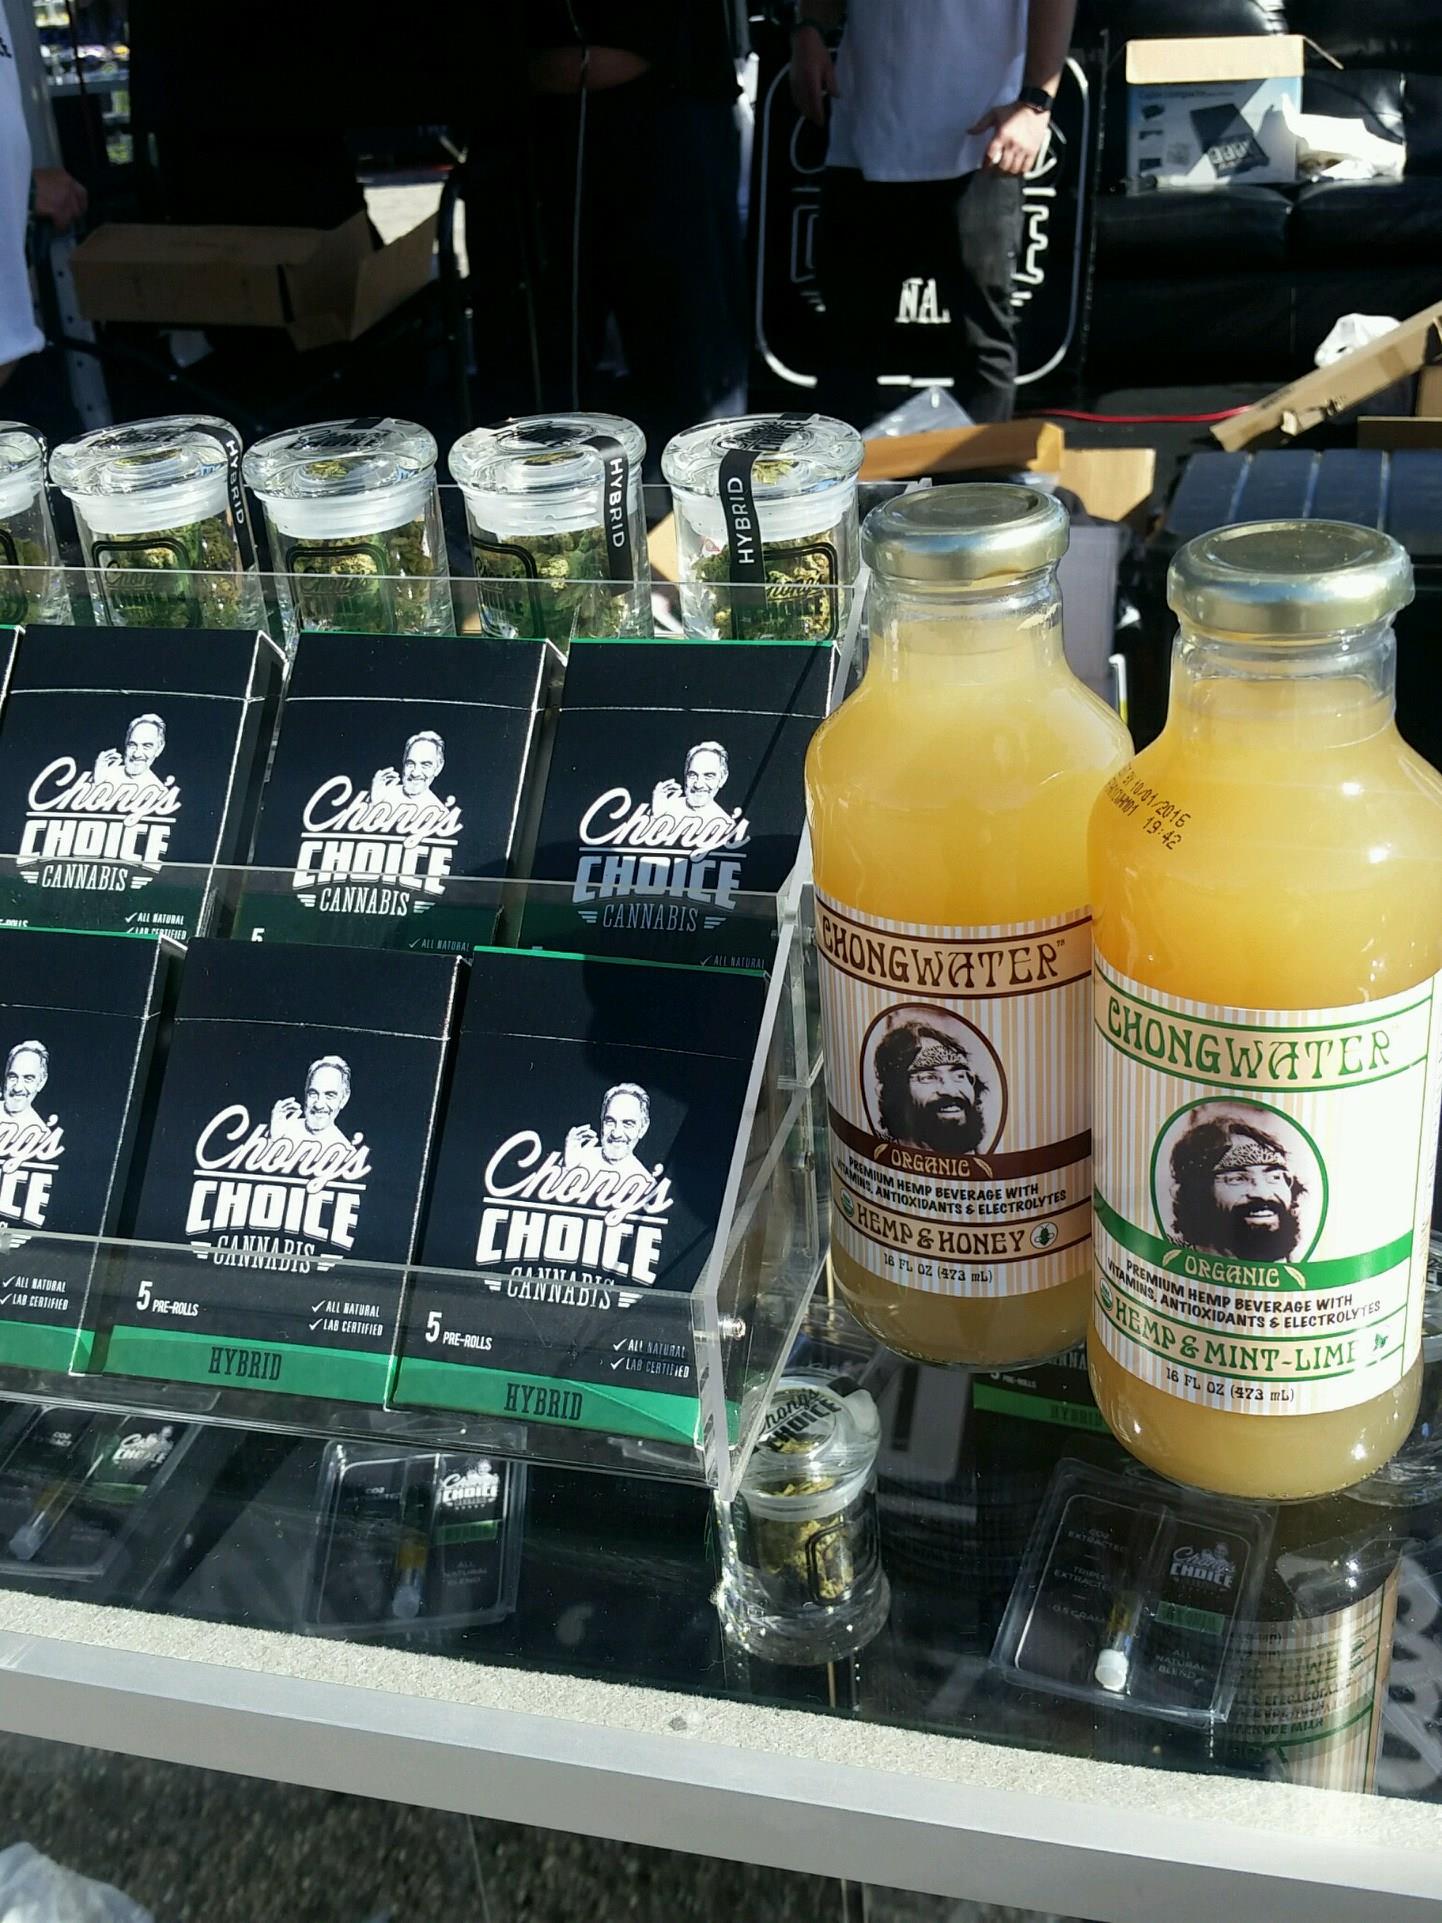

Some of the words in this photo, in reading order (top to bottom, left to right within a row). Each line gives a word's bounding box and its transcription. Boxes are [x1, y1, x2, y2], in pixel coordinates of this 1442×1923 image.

[225, 440, 246, 525] HYBRID
[608, 457, 626, 549] HYBRID
[727, 476, 755, 564] HYBRID
[28, 757, 182, 827] Chong's
[302, 775, 464, 849] Chong's
[16, 819, 172, 874] CHOICE
[579, 787, 751, 863] Chong's
[41, 864, 128, 892] CANNABIS
[292, 840, 454, 896] CHOICE
[572, 855, 743, 911] CHOICE
[137, 911, 150, 923] ALL
[152, 912, 185, 926] NATURAL
[319, 887, 411, 917] CANNABIS
[602, 902, 699, 932] CANNABIS
[822, 914, 1059, 988] CHONGWATER
[1107, 995, 1391, 1081] CHONGWATER
[195, 1104, 373, 1194] Chong's
[891, 1149, 971, 1178] ORGANIC
[484, 1130, 674, 1227] Chong's
[848, 1156, 894, 1188] PREMIUM
[896, 1179, 932, 1197] HEMP
[935, 1185, 1003, 1201] BEVERAGE
[1005, 1182, 1040, 1200] WITH
[185, 1179, 361, 1251] CHOICE
[875, 1186, 963, 1216] ANTIOXIDANTS
[965, 1204, 976, 1216] &
[978, 1189, 1068, 1216] ELECTROLYTES
[475, 1207, 663, 1288] CHOICE
[857, 1202, 914, 1244] HEMP
[917, 1227, 936, 1250] &
[938, 1229, 1025, 1256] HONEY
[213, 1235, 316, 1274] CANNABIS
[883, 1252, 896, 1267] 16
[898, 1258, 914, 1273] FL
[917, 1262, 934, 1277] OZ
[937, 1264, 967, 1283] (473
[971, 1268, 993, 1284] mL)
[1184, 1255, 1281, 1287] ORGANIC
[12, 1293, 28, 1306] LAB
[29, 1295, 69, 1311] CERTIFIED
[15, 1275, 29, 1289] ALL
[31, 1277, 66, 1293] NATURAL
[136, 1280, 153, 1311] 5
[152, 1299, 200, 1317] PRE-ROLLS
[506, 1266, 616, 1311] CANNABIS
[1126, 1258, 1185, 1298] PREMIUM
[1188, 1287, 1232, 1309] HEMP
[1235, 1297, 1312, 1315] BEVERAGE
[1316, 1293, 1353, 1313] WITH
[322, 1319, 340, 1332] LAB
[341, 1321, 385, 1337] CERTIFIED
[325, 1301, 342, 1313] ALL
[343, 1302, 381, 1318] NATURAL
[425, 1310, 443, 1343] 5
[442, 1330, 494, 1351] PRE-ROLLS
[1115, 1296, 1178, 1349] HEMP
[1179, 1334, 1199, 1360] &
[1160, 1294, 1266, 1329] ANTIOXIDANTS
[1268, 1317, 1281, 1329] &
[1284, 1300, 1382, 1329] ELECTROLYTES
[207, 1346, 284, 1381] HYBRID
[625, 1356, 643, 1371] LAB
[645, 1359, 690, 1378] CERTIFIED
[628, 1338, 643, 1352] ALL
[647, 1340, 687, 1359] NATURAL
[504, 1382, 584, 1421] HYBRID
[1166, 1366, 1180, 1384] 16
[1184, 1374, 1201, 1391] FL
[1206, 1381, 1225, 1397] OZ
[1229, 1383, 1264, 1402] (473
[1269, 1385, 1295, 1403] mL)
[765, 1387, 820, 1430] hong's
[767, 1398, 842, 1451] CHOICE
